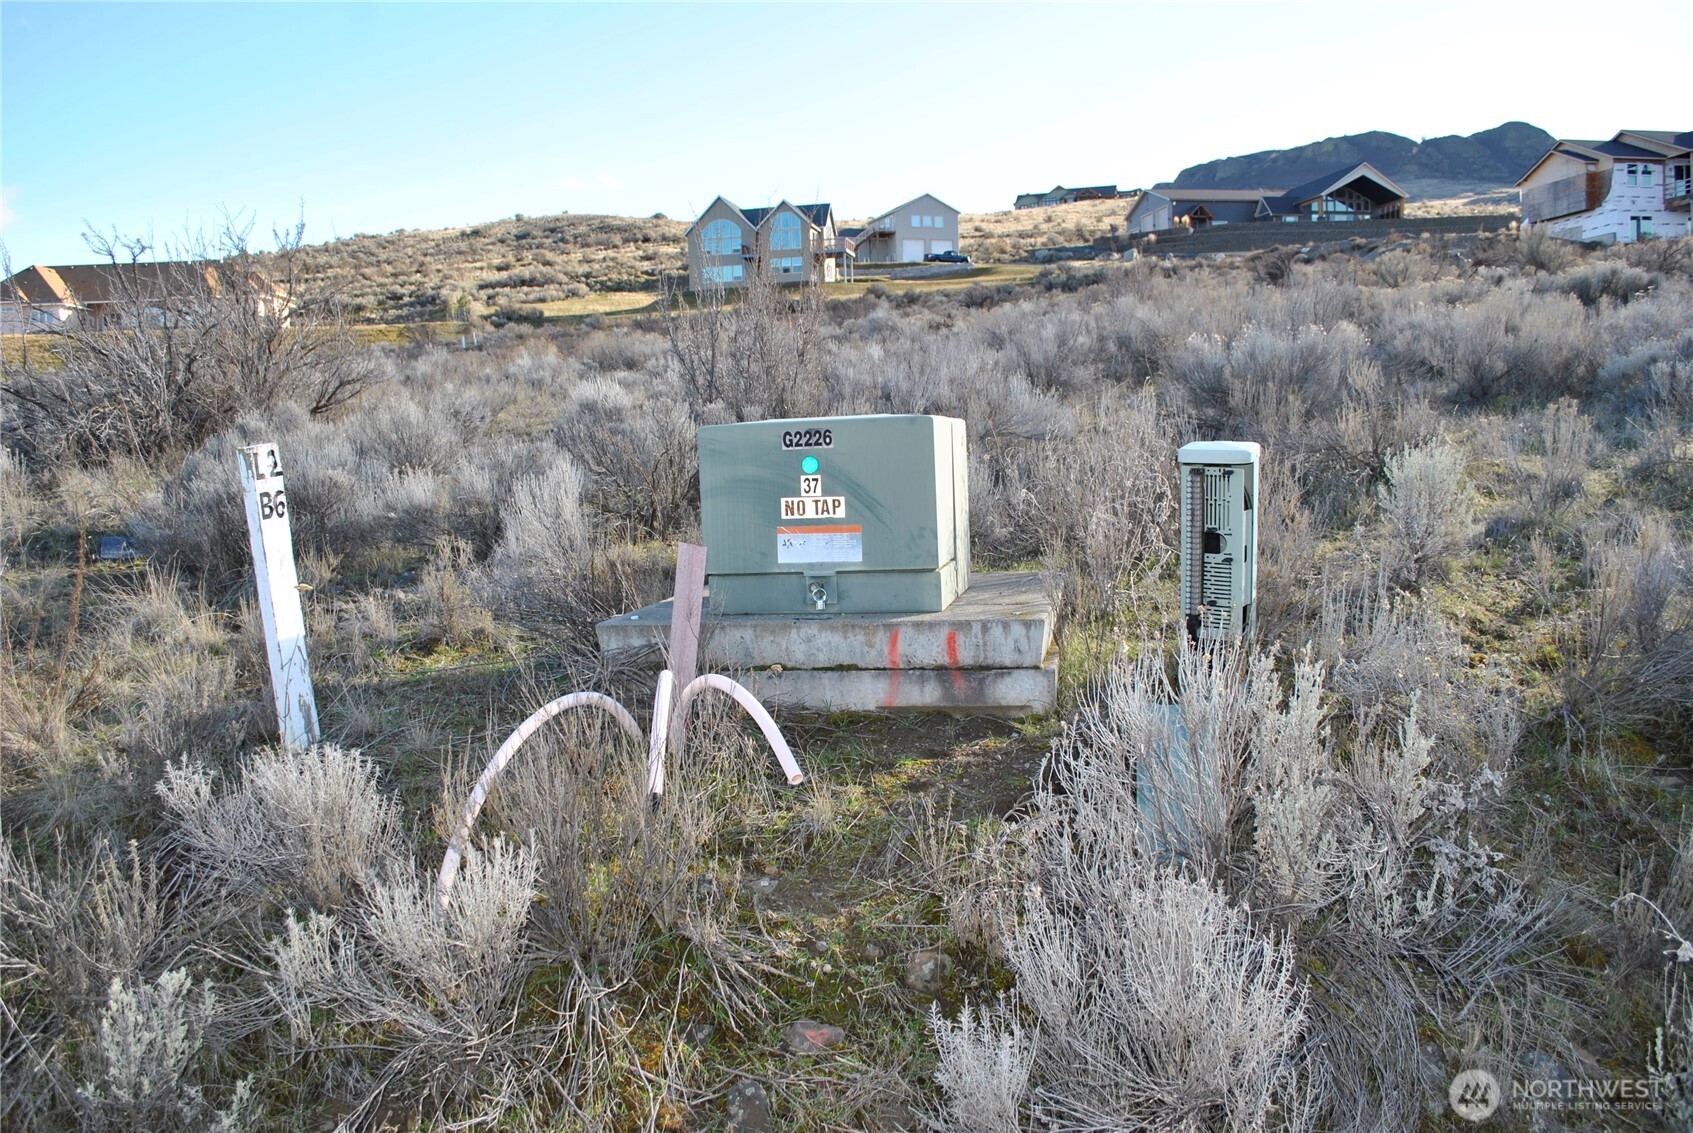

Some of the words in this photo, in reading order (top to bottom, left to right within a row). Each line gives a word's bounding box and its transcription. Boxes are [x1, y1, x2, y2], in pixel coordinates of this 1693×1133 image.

[782, 429, 833, 448] G2226
[803, 477, 819, 494] 37
[259, 490, 286, 520] B6
[784, 499, 806, 517] NO
[811, 498, 842, 516] TAP
